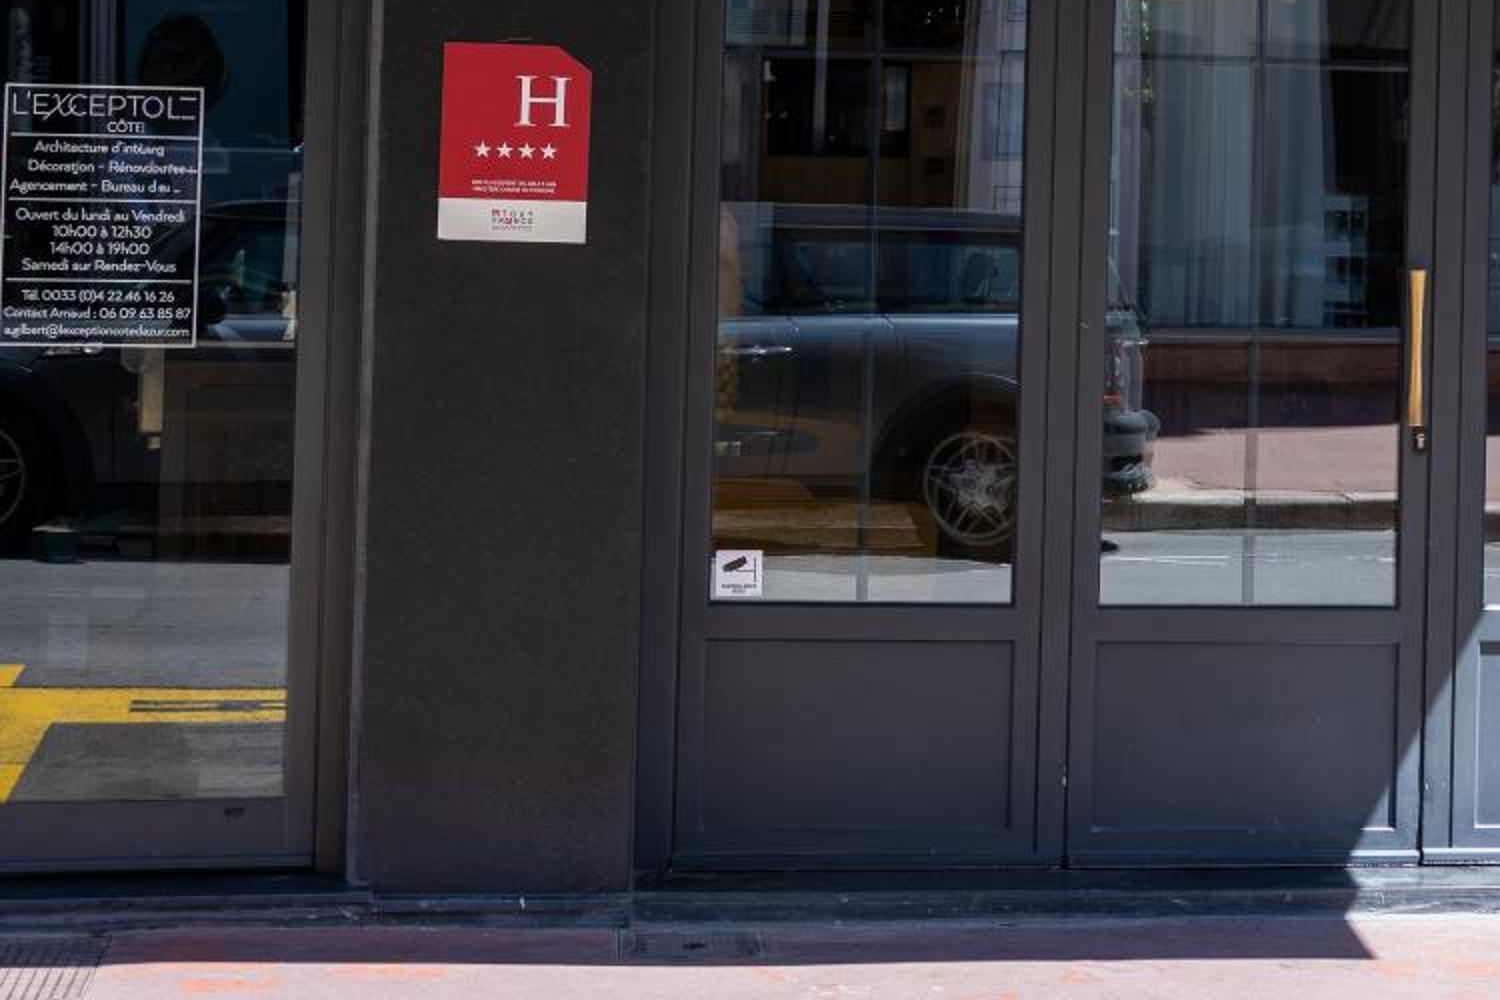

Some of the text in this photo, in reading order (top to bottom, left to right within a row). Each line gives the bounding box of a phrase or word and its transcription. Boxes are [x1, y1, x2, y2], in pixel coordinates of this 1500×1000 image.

[514, 75, 572, 127] H
[34, 139, 108, 153] Architecture
[28, 159, 95, 174] Décoration
[10, 178, 89, 194] Agencement
[101, 179, 145, 193] Bureau
[15, 208, 185, 223] Ouvert du lundi au Vendredi
[53, 225, 97, 238] 10h00
[111, 226, 152, 239] 12h30
[49, 241, 93, 254] 14h00
[108, 242, 150, 255] 19h00
[21, 257, 176, 273] Samedi sur Rendez-Vous
[42, 289, 76, 301] 0033
[106, 290, 122, 302] 22
[159, 291, 175, 303] 26
[3, 306, 47, 318] Contact
[50, 307, 91, 319] Arnaud
[99, 307, 116, 319] 06
[119, 308, 136, 319] 09
[139, 308, 154, 319] 63
[157, 308, 173, 320] 85
[175, 308, 191, 320] 87
